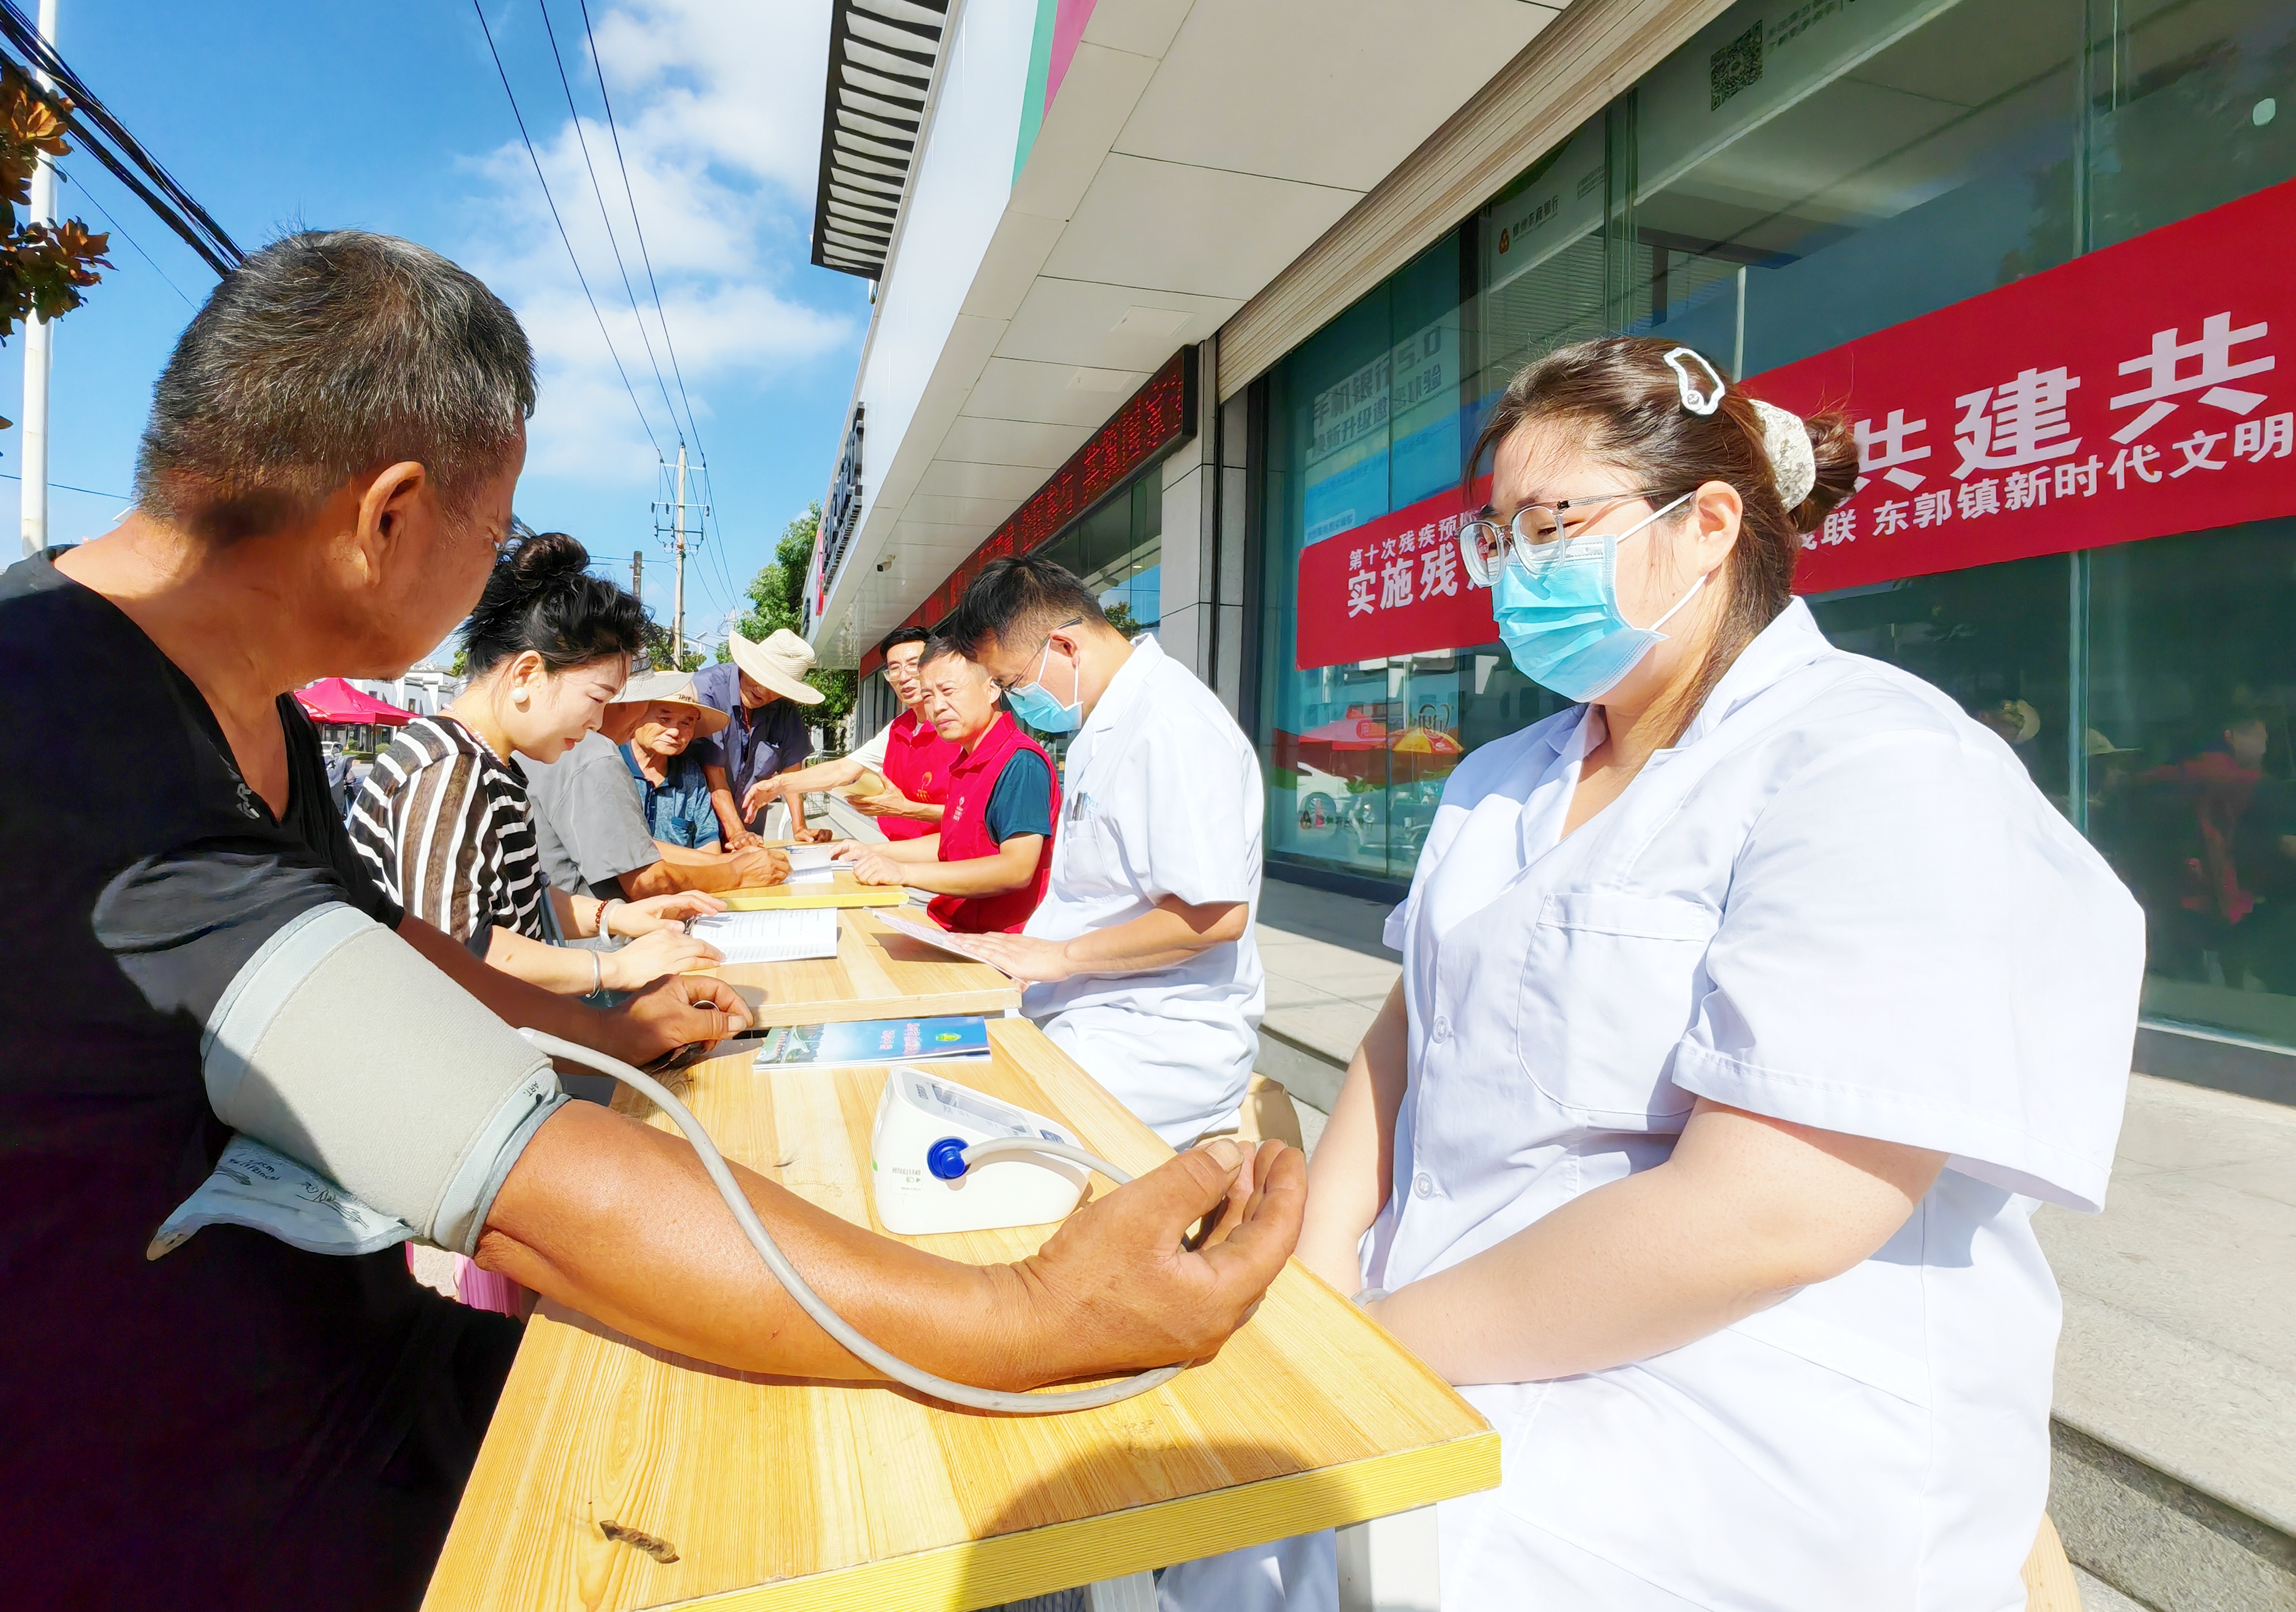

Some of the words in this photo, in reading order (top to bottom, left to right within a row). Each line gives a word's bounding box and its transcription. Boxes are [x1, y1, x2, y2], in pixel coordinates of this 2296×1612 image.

[1836, 311, 2275, 508] 共建共
[1872, 411, 2294, 536] 东郭镇新时代文明
[1348, 542, 1475, 619] 实施残
